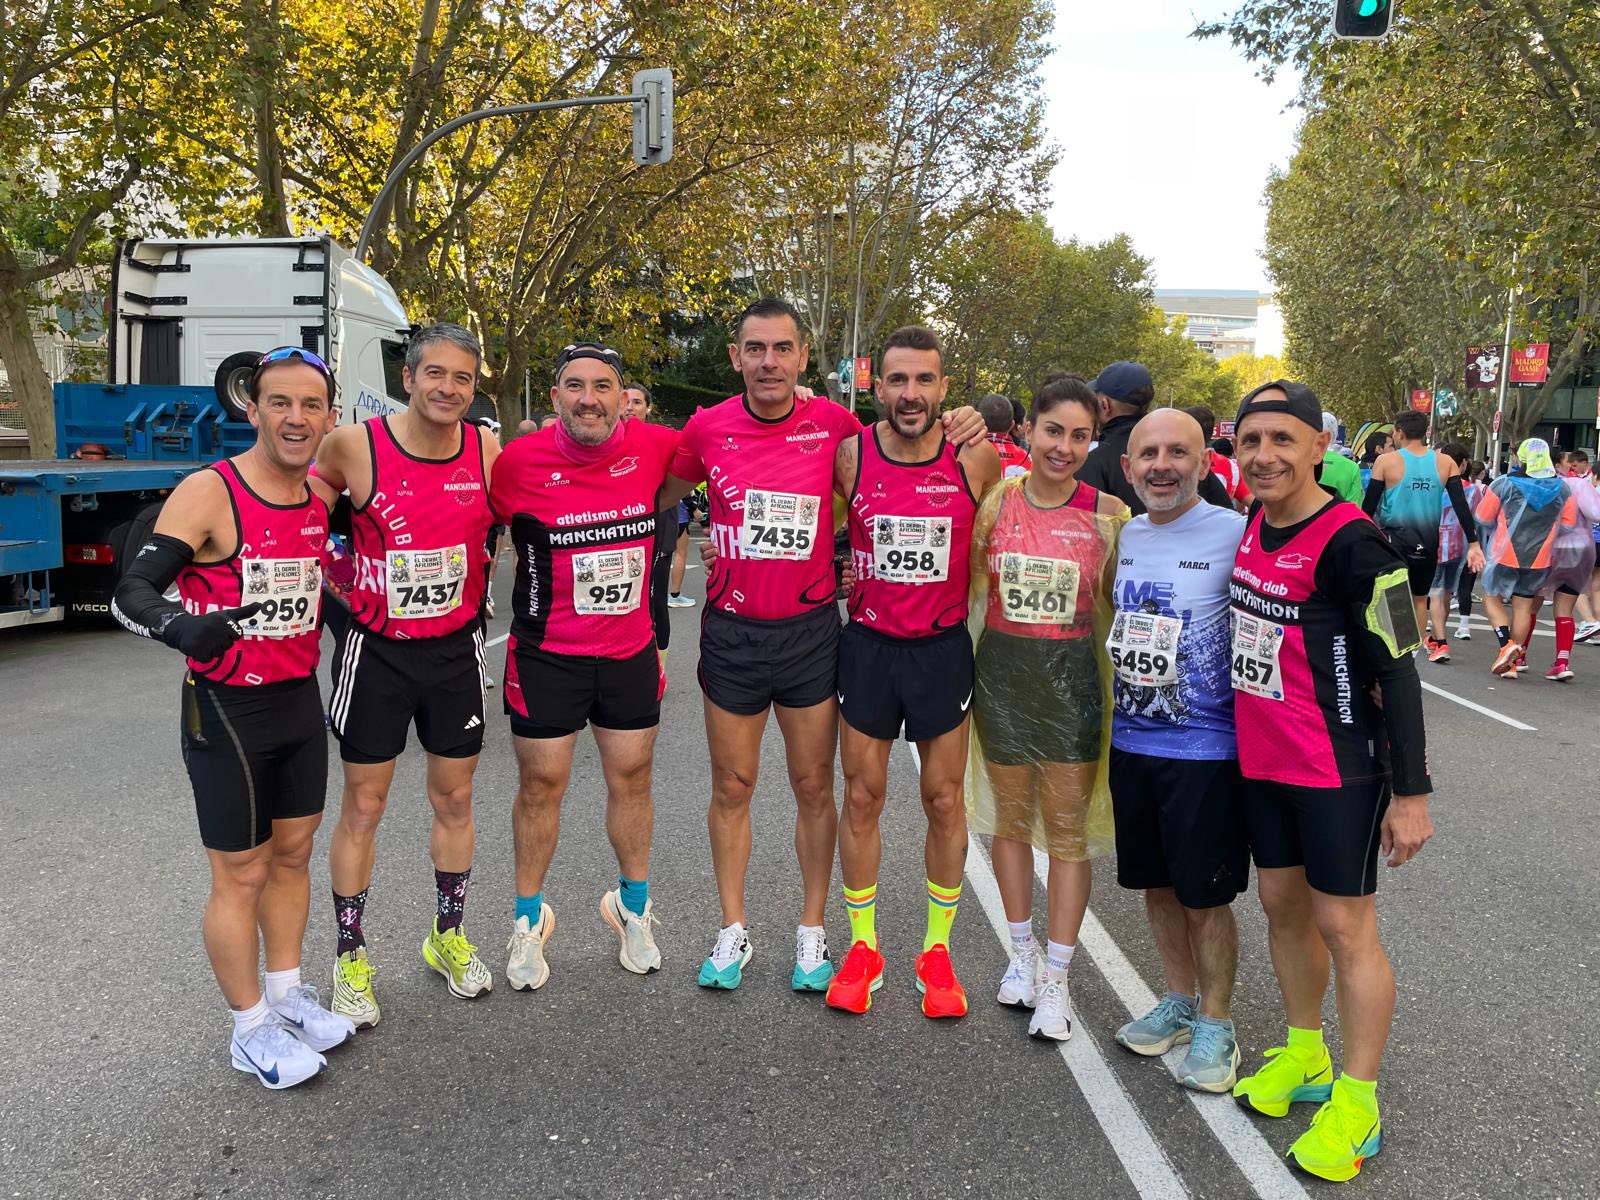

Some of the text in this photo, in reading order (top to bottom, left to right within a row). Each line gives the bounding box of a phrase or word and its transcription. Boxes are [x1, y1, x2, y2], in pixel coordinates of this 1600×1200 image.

[786, 431, 830, 442] MANCHATHON
[444, 482, 480, 492] MANCHATHON
[544, 480, 570, 488] VIATOR
[916, 485, 959, 494] MANCHATHON
[1412, 482, 1430, 491] PR
[372, 491, 412, 546] CLUB
[556, 503, 646, 526] atletismo club
[550, 518, 656, 546] MANCHATHON
[750, 525, 810, 550] 7435
[887, 550, 934, 571] 958
[1178, 560, 1210, 570] MARCA
[397, 580, 459, 608] 7437
[589, 582, 632, 604] 957
[1262, 581, 1288, 596] club
[72, 604, 108, 612] IVECO
[260, 597, 308, 622] 959
[1008, 588, 1066, 612] 5461
[226, 620, 242, 636] FILA
[1111, 646, 1168, 676] 5459
[1334, 634, 1354, 724] MANCHATHON
